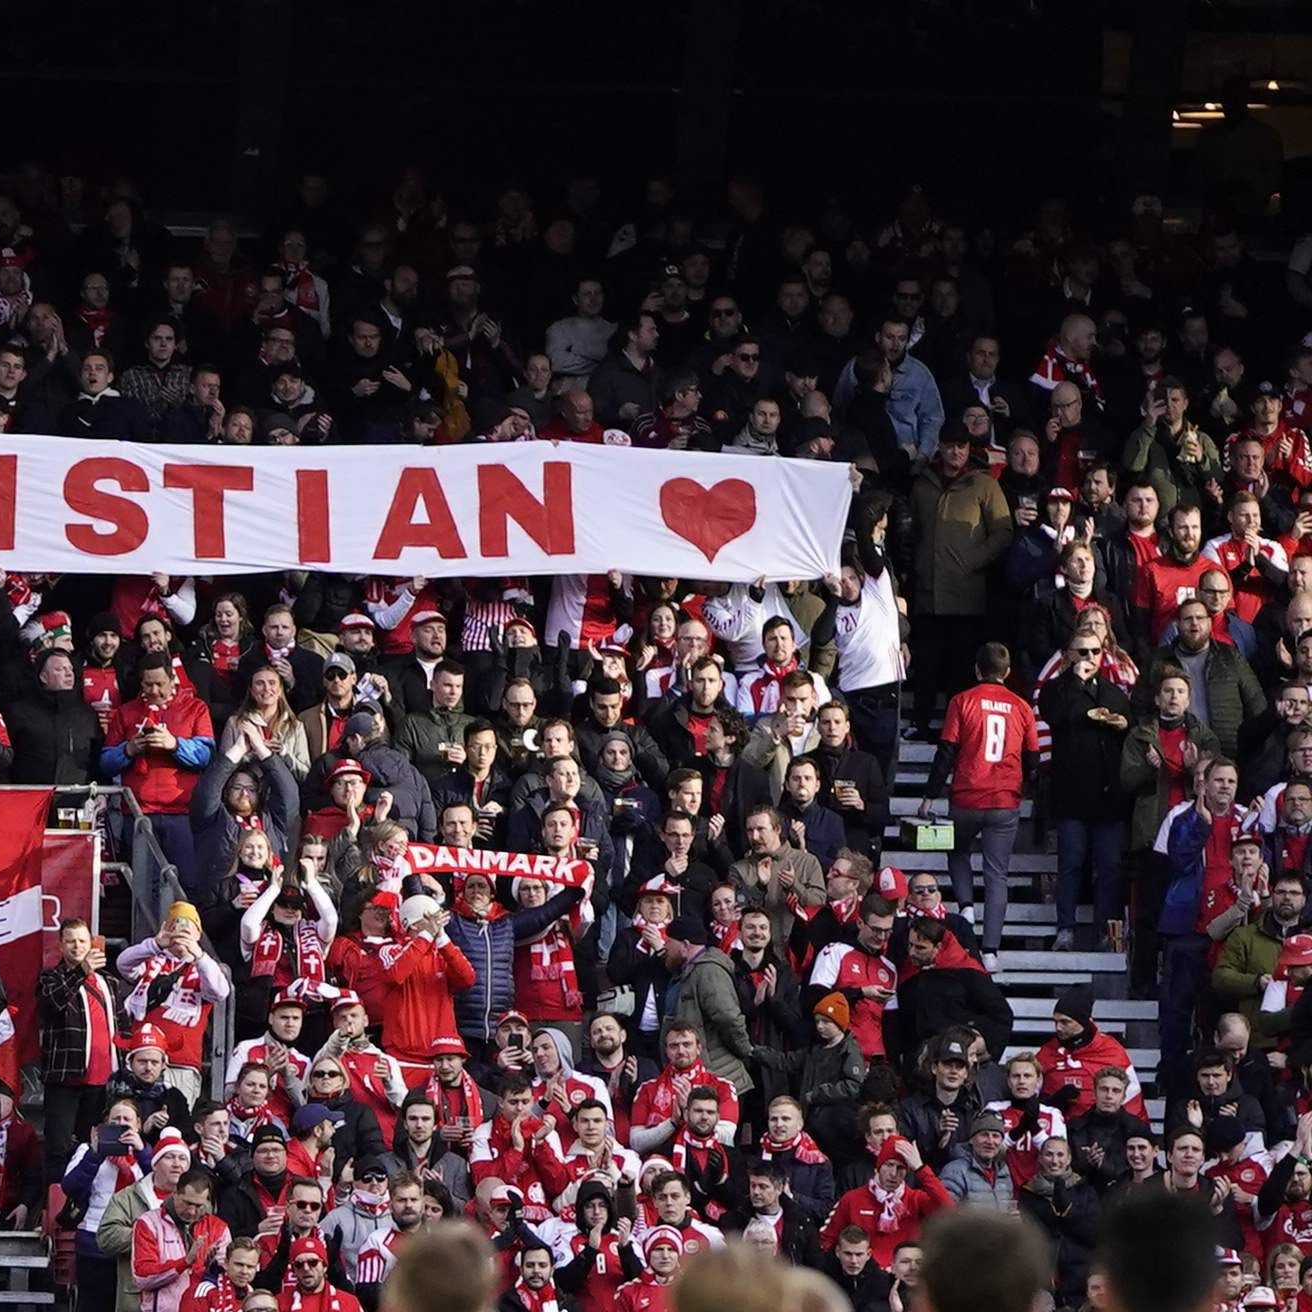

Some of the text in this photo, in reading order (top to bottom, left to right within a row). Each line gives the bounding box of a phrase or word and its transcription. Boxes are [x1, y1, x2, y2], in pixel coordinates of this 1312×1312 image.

[984, 714, 1007, 762] 8
[412, 845, 579, 882] DANMARK
[596, 1252, 606, 1275] 8
